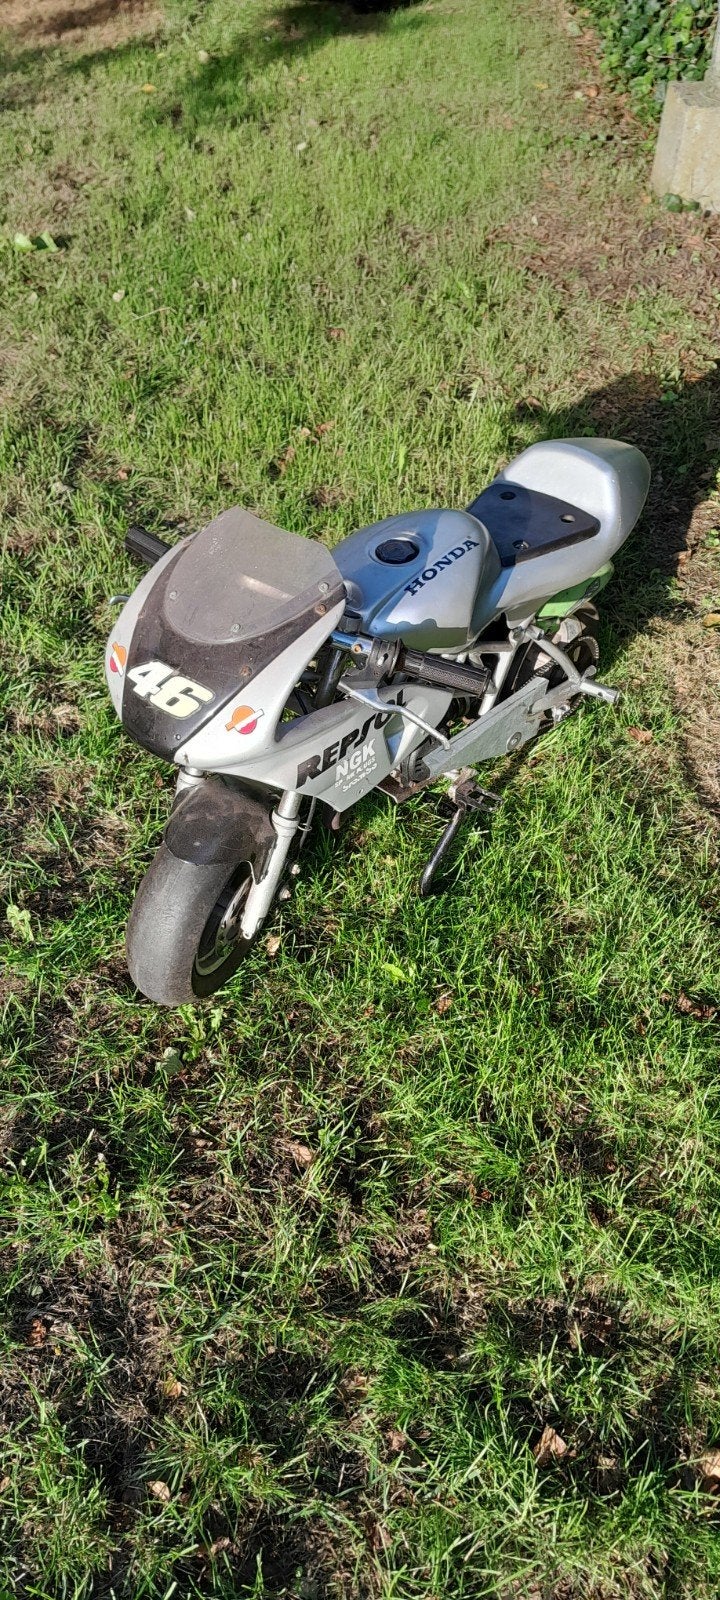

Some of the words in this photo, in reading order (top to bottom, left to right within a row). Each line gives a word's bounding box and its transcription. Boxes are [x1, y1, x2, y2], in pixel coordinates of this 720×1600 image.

[404, 540, 480, 596] HONDA
[126, 660, 215, 719] 46
[336, 738, 376, 782] NGK
